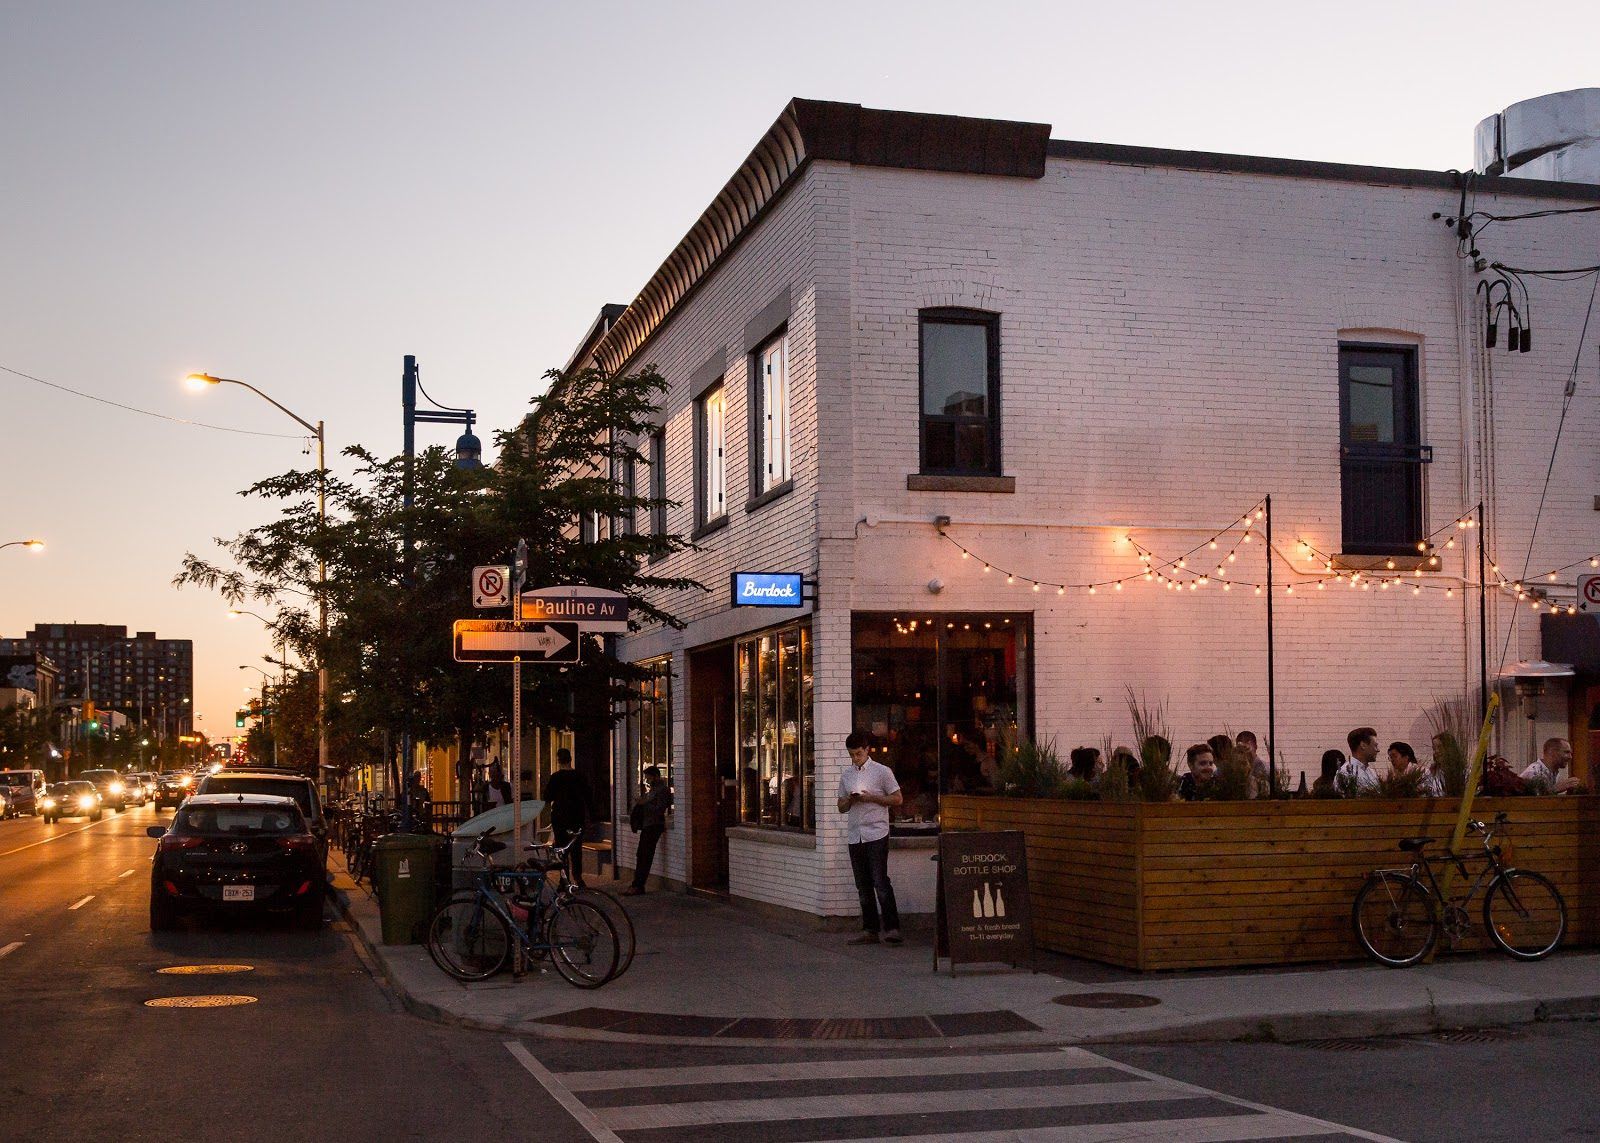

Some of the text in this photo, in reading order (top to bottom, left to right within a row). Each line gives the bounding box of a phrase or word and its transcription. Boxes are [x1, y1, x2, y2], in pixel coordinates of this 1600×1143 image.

[742, 580, 796, 597] Burdock
[535, 598, 615, 615] Pauline Av
[962, 854, 1007, 863] BURDOCK
[953, 865, 1016, 875] BOTTLE SHOP
[984, 923, 1001, 931] fresh
[986, 933, 1014, 941] everyday
